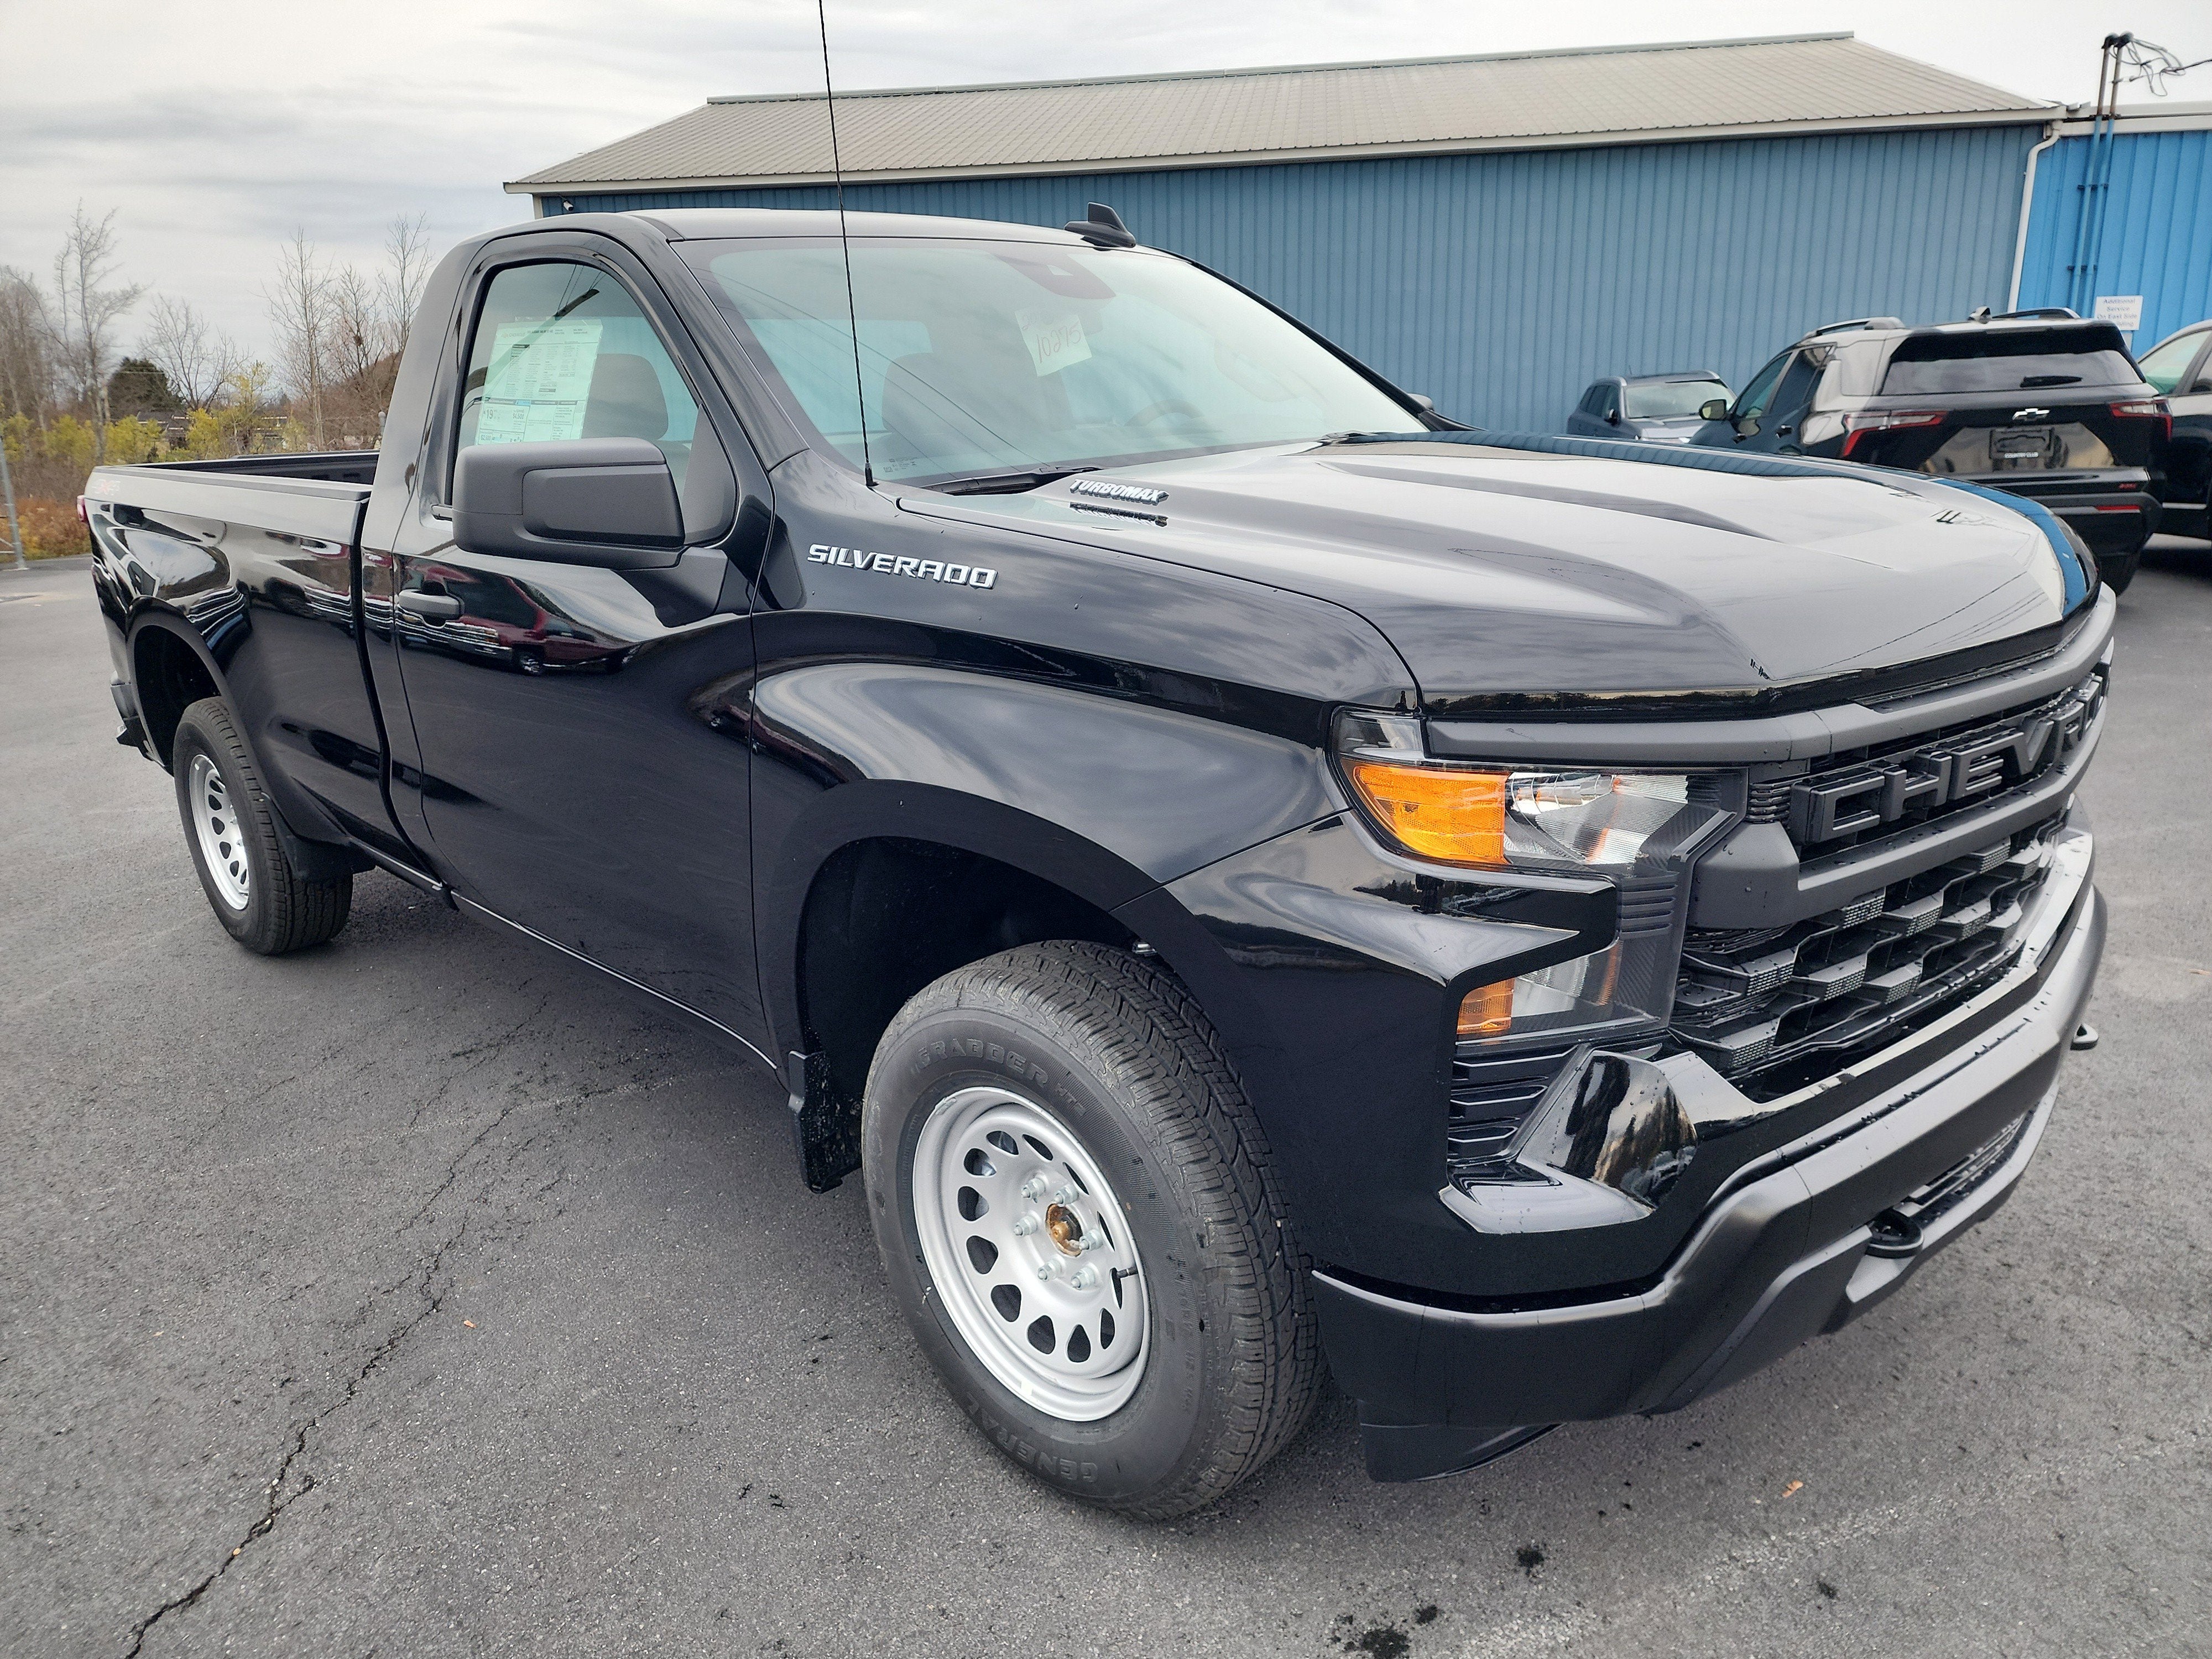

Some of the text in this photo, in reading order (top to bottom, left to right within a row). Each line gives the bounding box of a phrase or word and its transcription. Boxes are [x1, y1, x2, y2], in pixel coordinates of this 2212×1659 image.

[1036, 320, 1081, 363] 10275
[487, 409, 493, 419] 19
[1070, 479, 1170, 506] TURBOMAX
[807, 543, 998, 589] SILVERADO
[916, 1038, 1049, 1087] GRABBER
